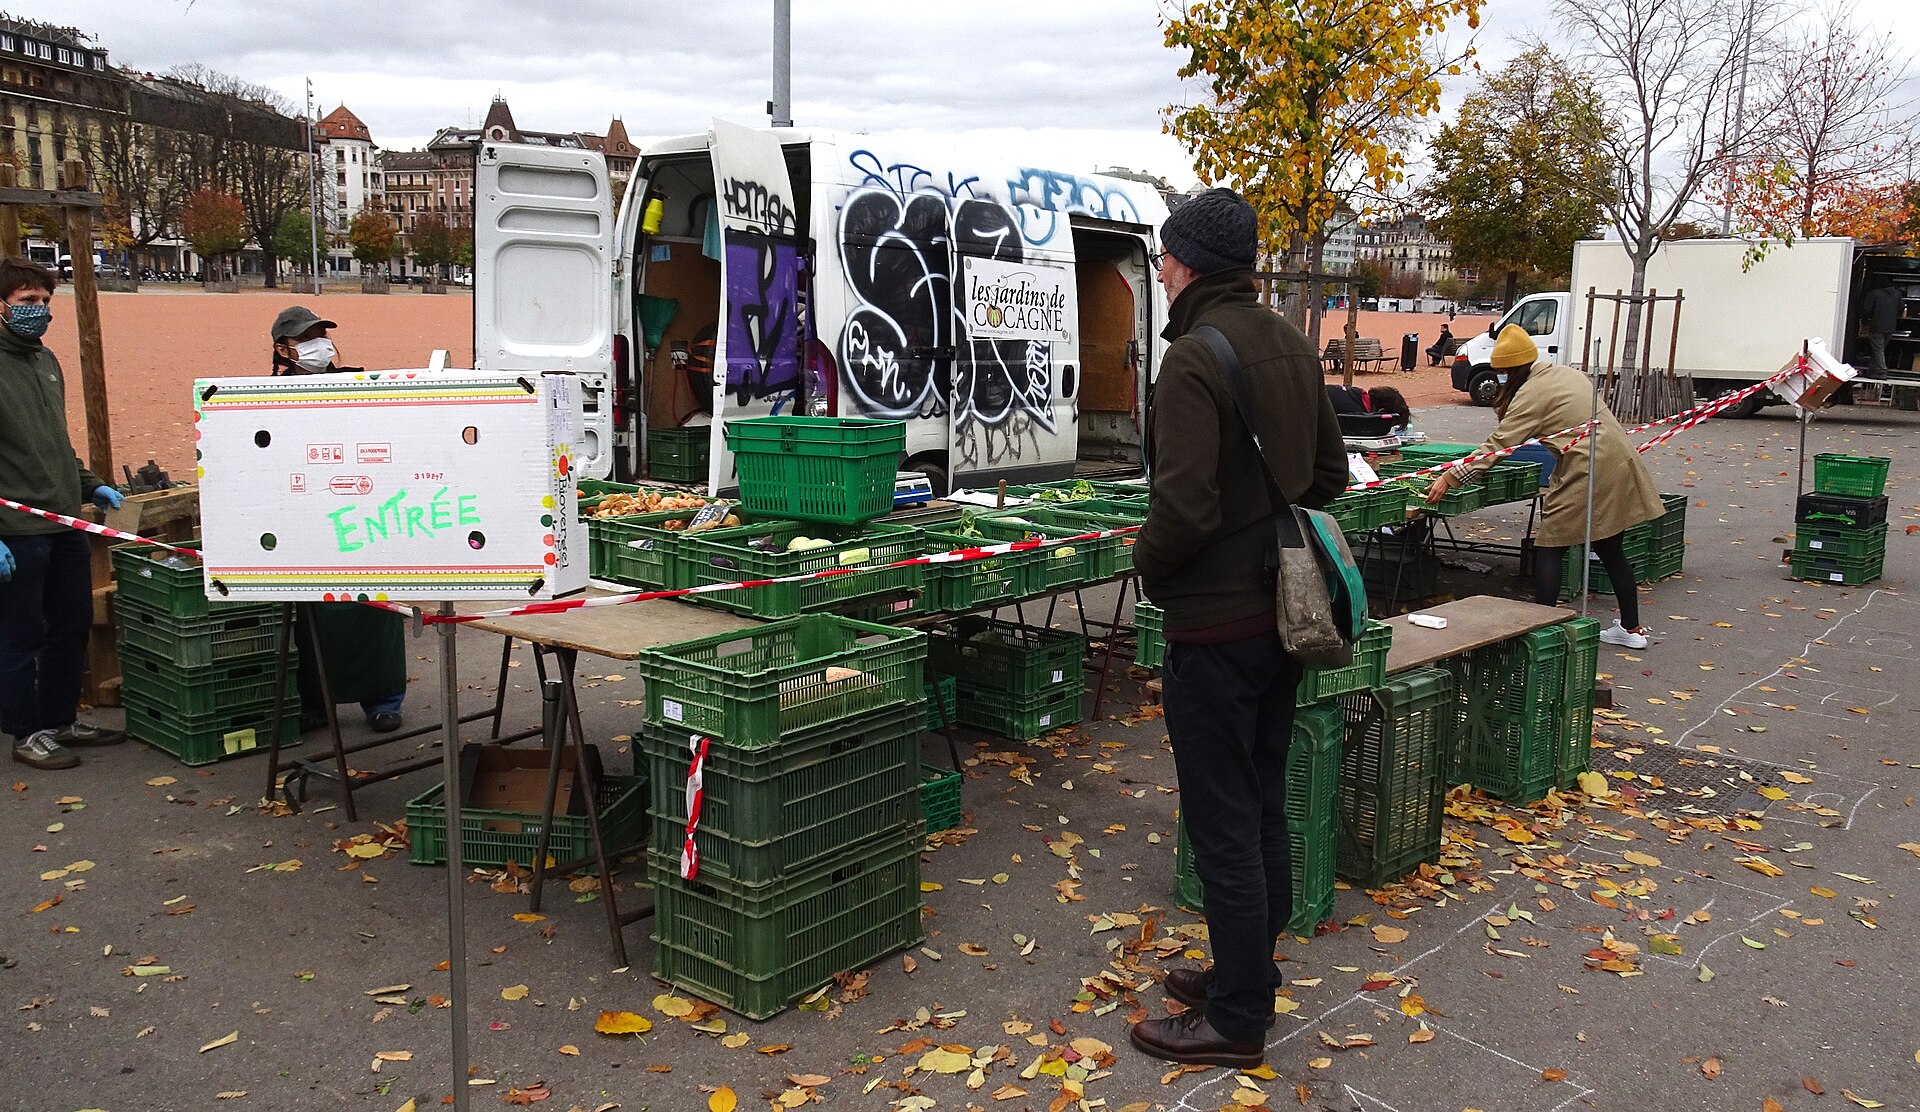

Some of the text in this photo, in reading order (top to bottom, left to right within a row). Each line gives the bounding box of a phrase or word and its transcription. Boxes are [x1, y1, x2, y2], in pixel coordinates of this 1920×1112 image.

[971, 275, 1065, 309] les jardins de
[974, 302, 1063, 332] COCAGNE
[326, 487, 482, 553] ENTRÉE
[557, 477, 570, 570] Biovergel
